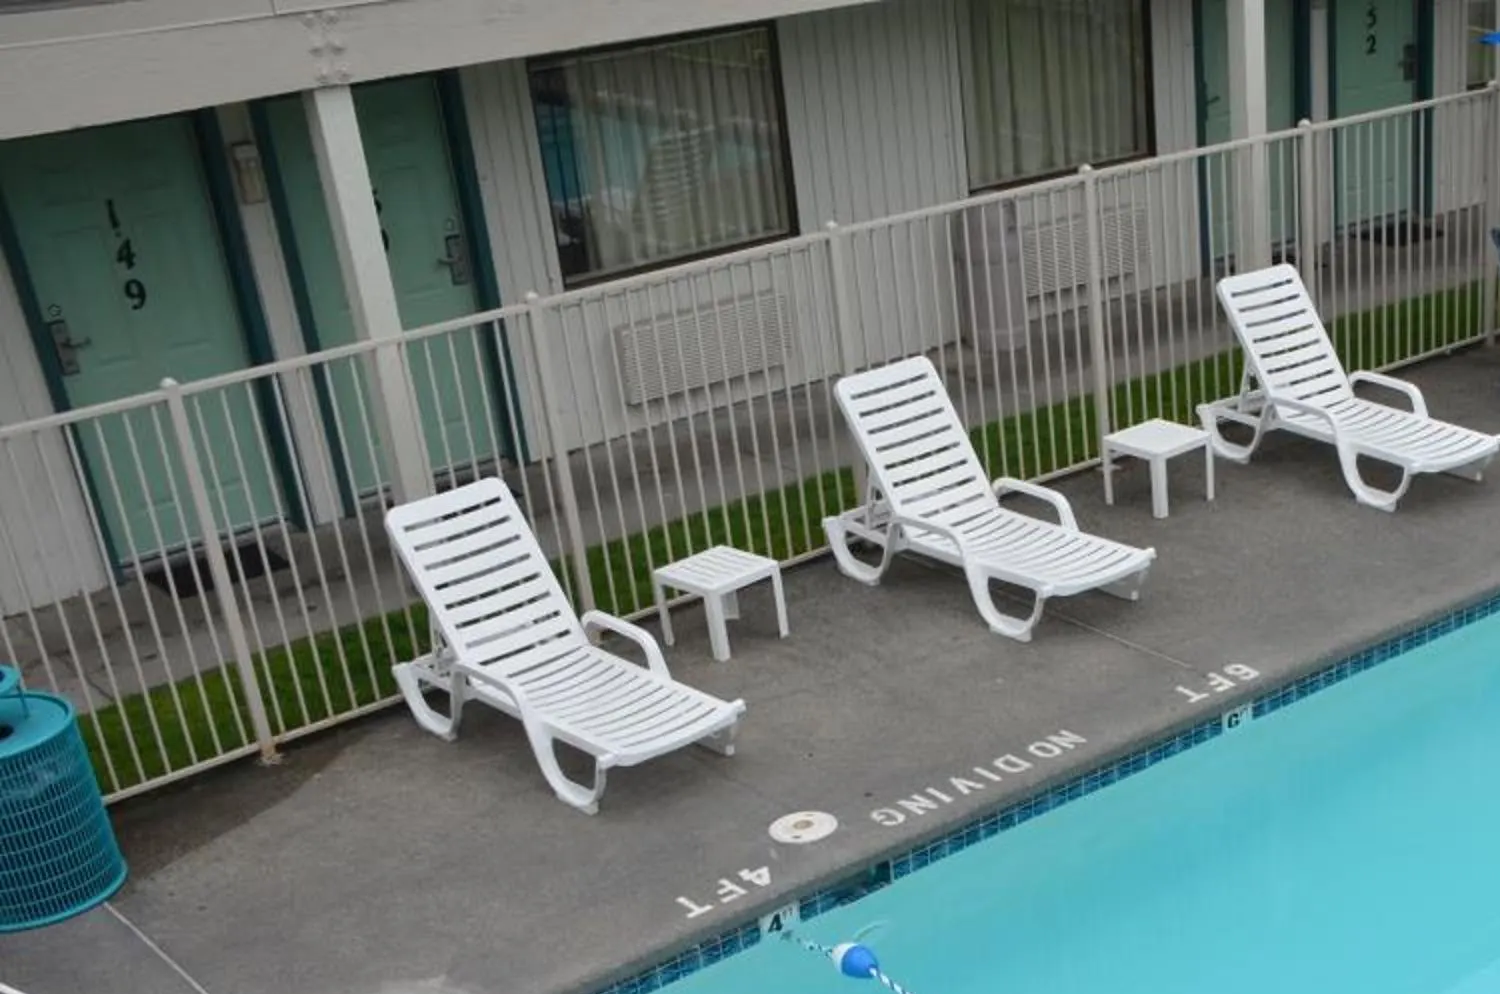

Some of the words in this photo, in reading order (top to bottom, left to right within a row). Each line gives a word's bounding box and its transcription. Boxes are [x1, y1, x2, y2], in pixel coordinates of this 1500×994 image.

[105, 198, 147, 311] 149
[1175, 663, 1260, 703] 6FT
[1028, 729, 1088, 758] NO
[869, 753, 1034, 826] DIVING
[675, 865, 772, 918] 4FT
